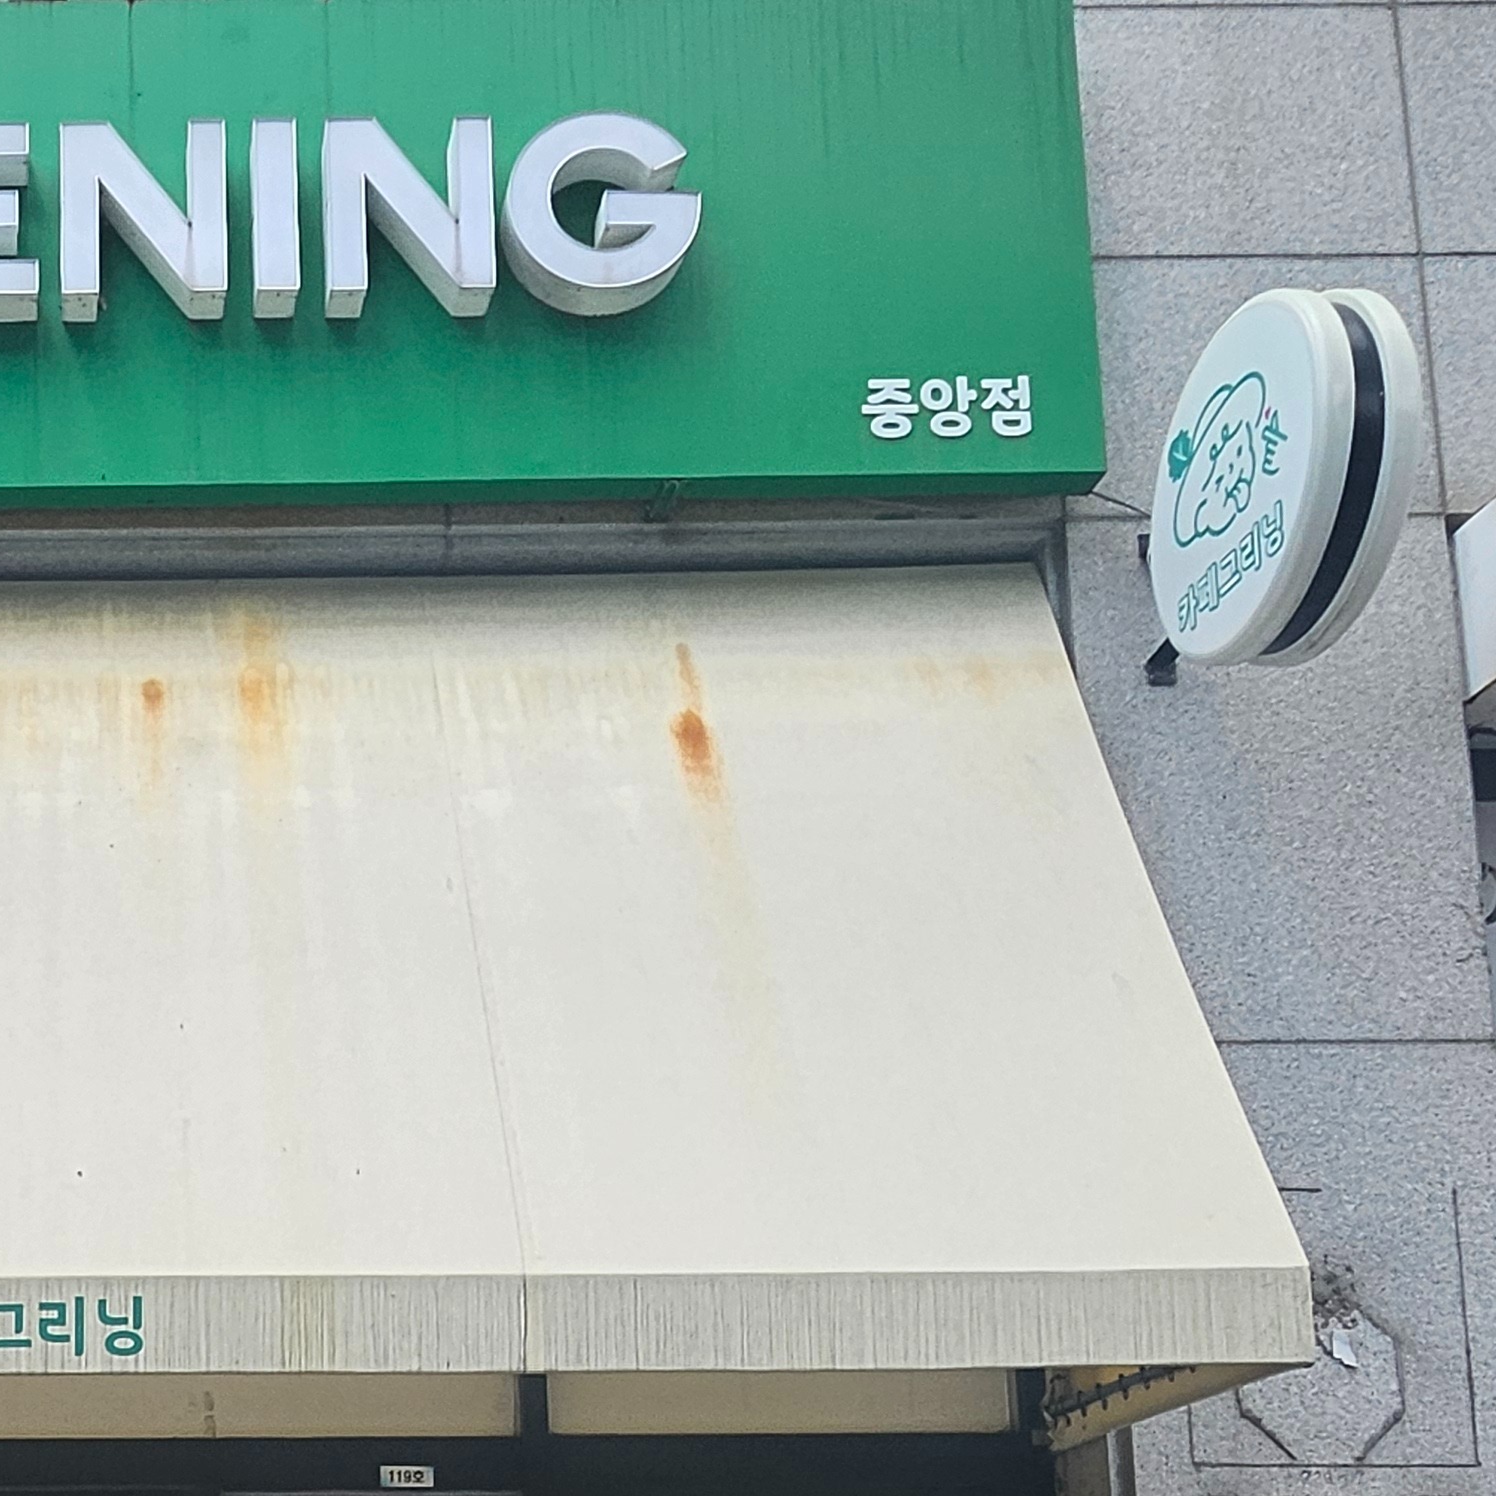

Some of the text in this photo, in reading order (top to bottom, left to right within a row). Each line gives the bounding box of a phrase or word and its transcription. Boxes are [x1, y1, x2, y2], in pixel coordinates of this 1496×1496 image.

[861, 375, 1033, 439] 중앙점
[1177, 499, 1285, 633] 카페그리닝
[387, 1469, 426, 1486] 119호
